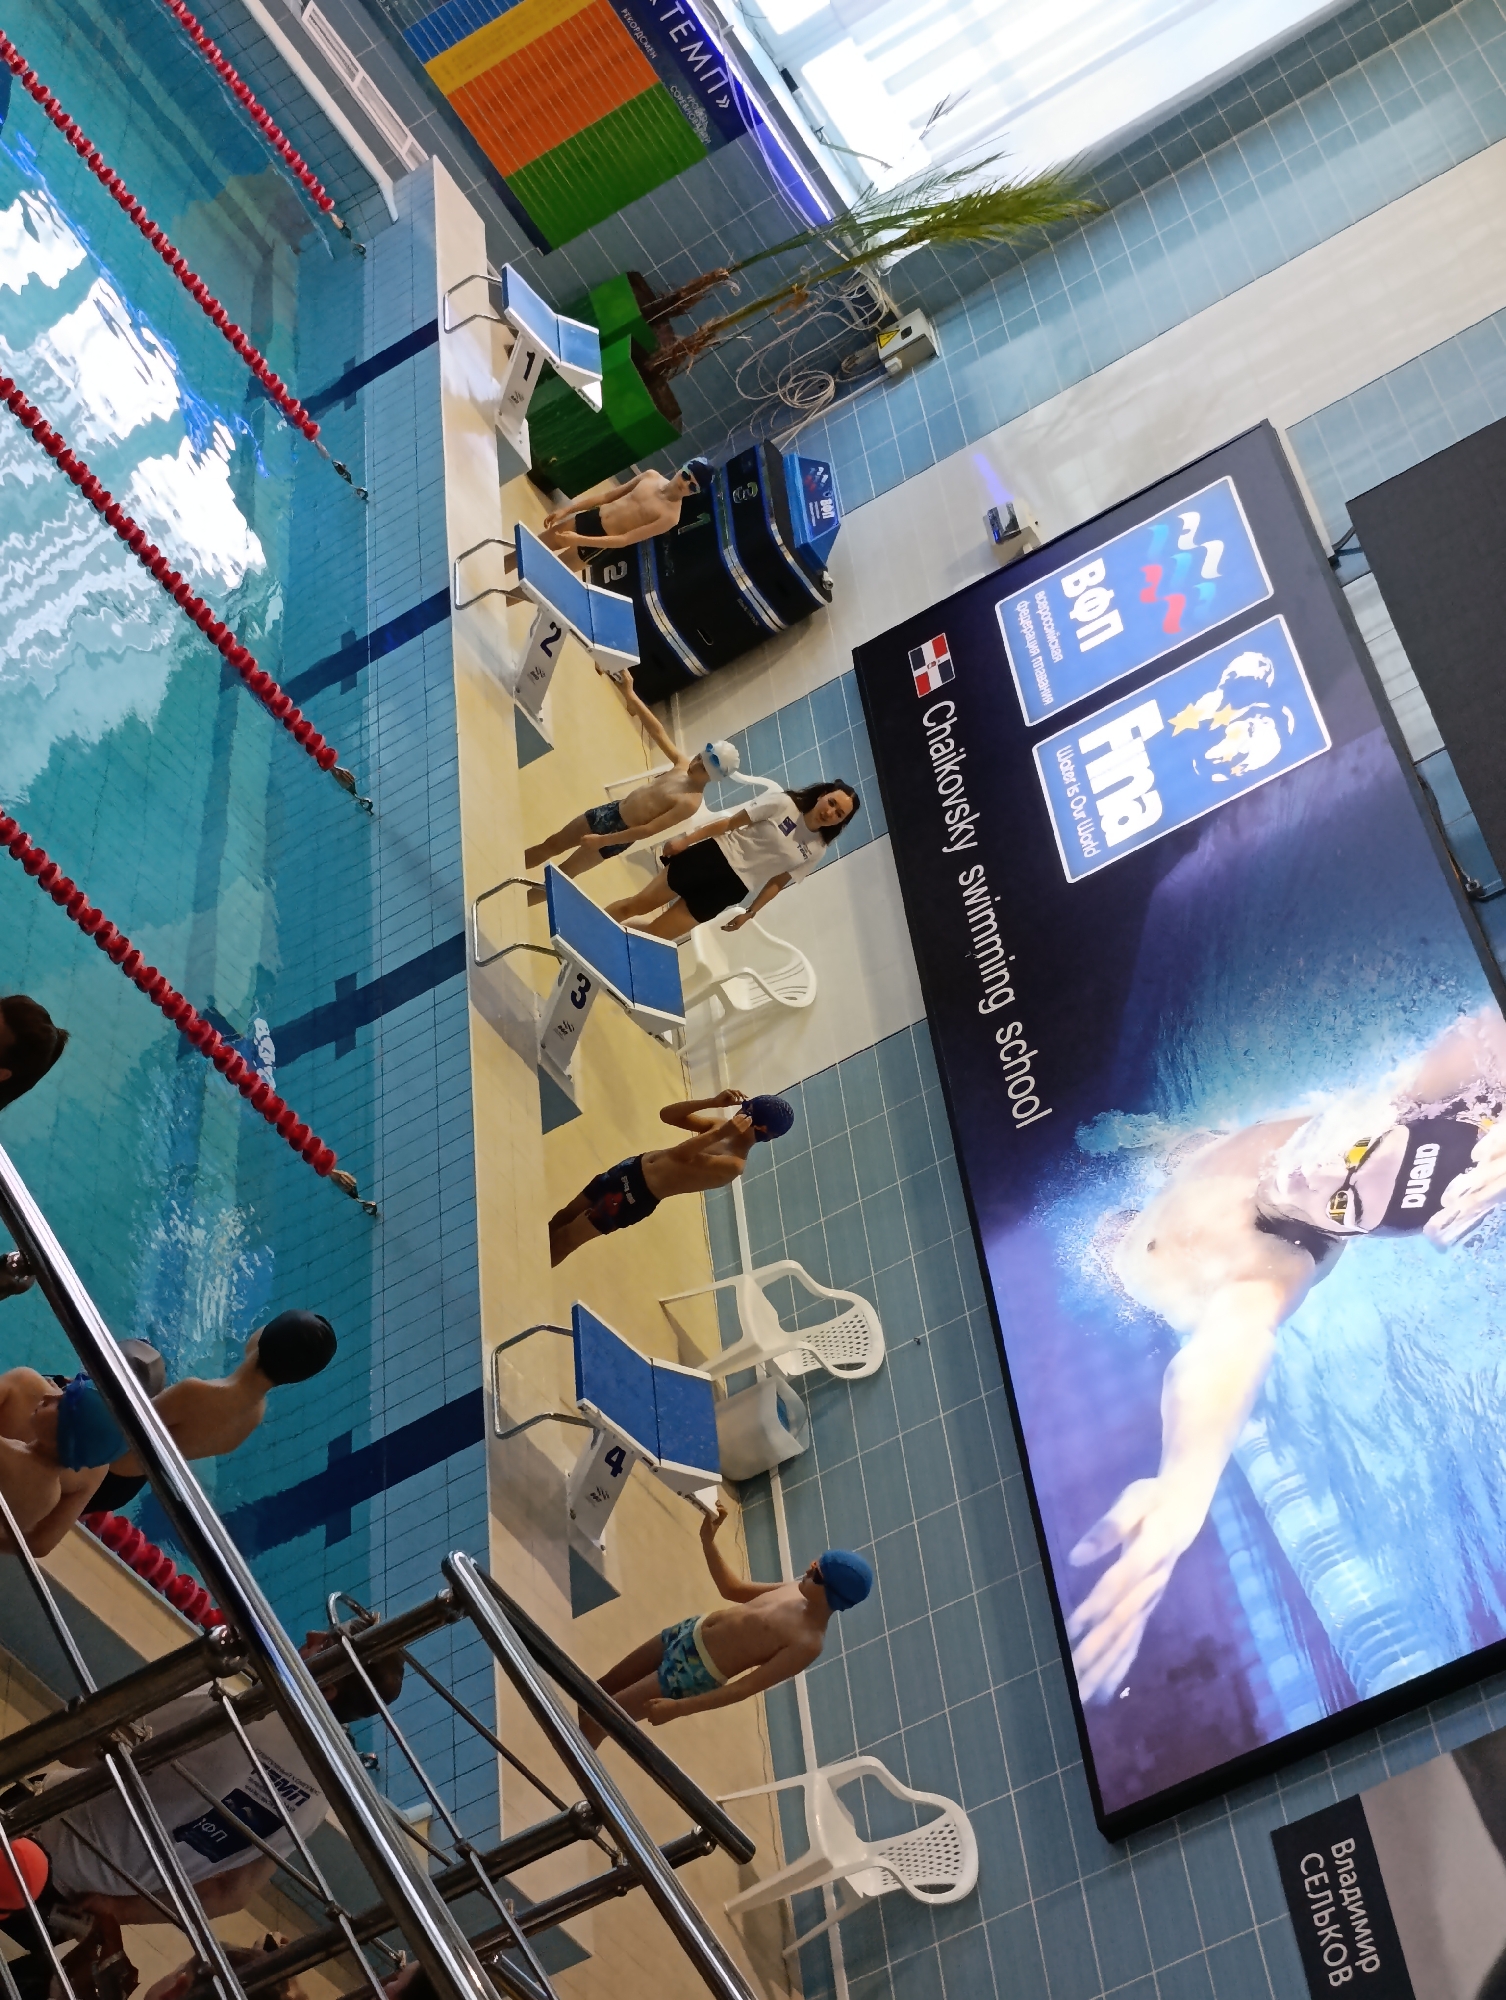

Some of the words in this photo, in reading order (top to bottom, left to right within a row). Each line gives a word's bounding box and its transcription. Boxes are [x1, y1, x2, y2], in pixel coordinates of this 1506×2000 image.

[650, 0, 731, 108] ТЕМП»
[523, 351, 535, 381] 1
[732, 482, 758, 503] 3
[678, 512, 711, 535] 1
[603, 561, 628, 584] 2
[1061, 558, 1124, 652] ВФП
[540, 621, 562, 658] 2
[1035, 590, 1063, 663] всероссийская
[1015, 600, 1041, 658] федерация
[1031, 656, 1054, 706] плавания
[1056, 745, 1076, 784] Water
[1066, 783, 1081, 797] is
[1070, 796, 1087, 820] Our
[1077, 818, 1101, 858] World
[922, 700, 981, 853] Chaikovsky
[958, 864, 1016, 1014] swimming
[995, 1021, 1053, 1129] school
[571, 973, 591, 1009] 3
[1401, 1143, 1440, 1209] arena
[605, 1445, 626, 1477] 4
[1300, 1852, 1353, 1987] СЕЛЬКОВ
[1331, 1837, 1381, 1973] Владимир
